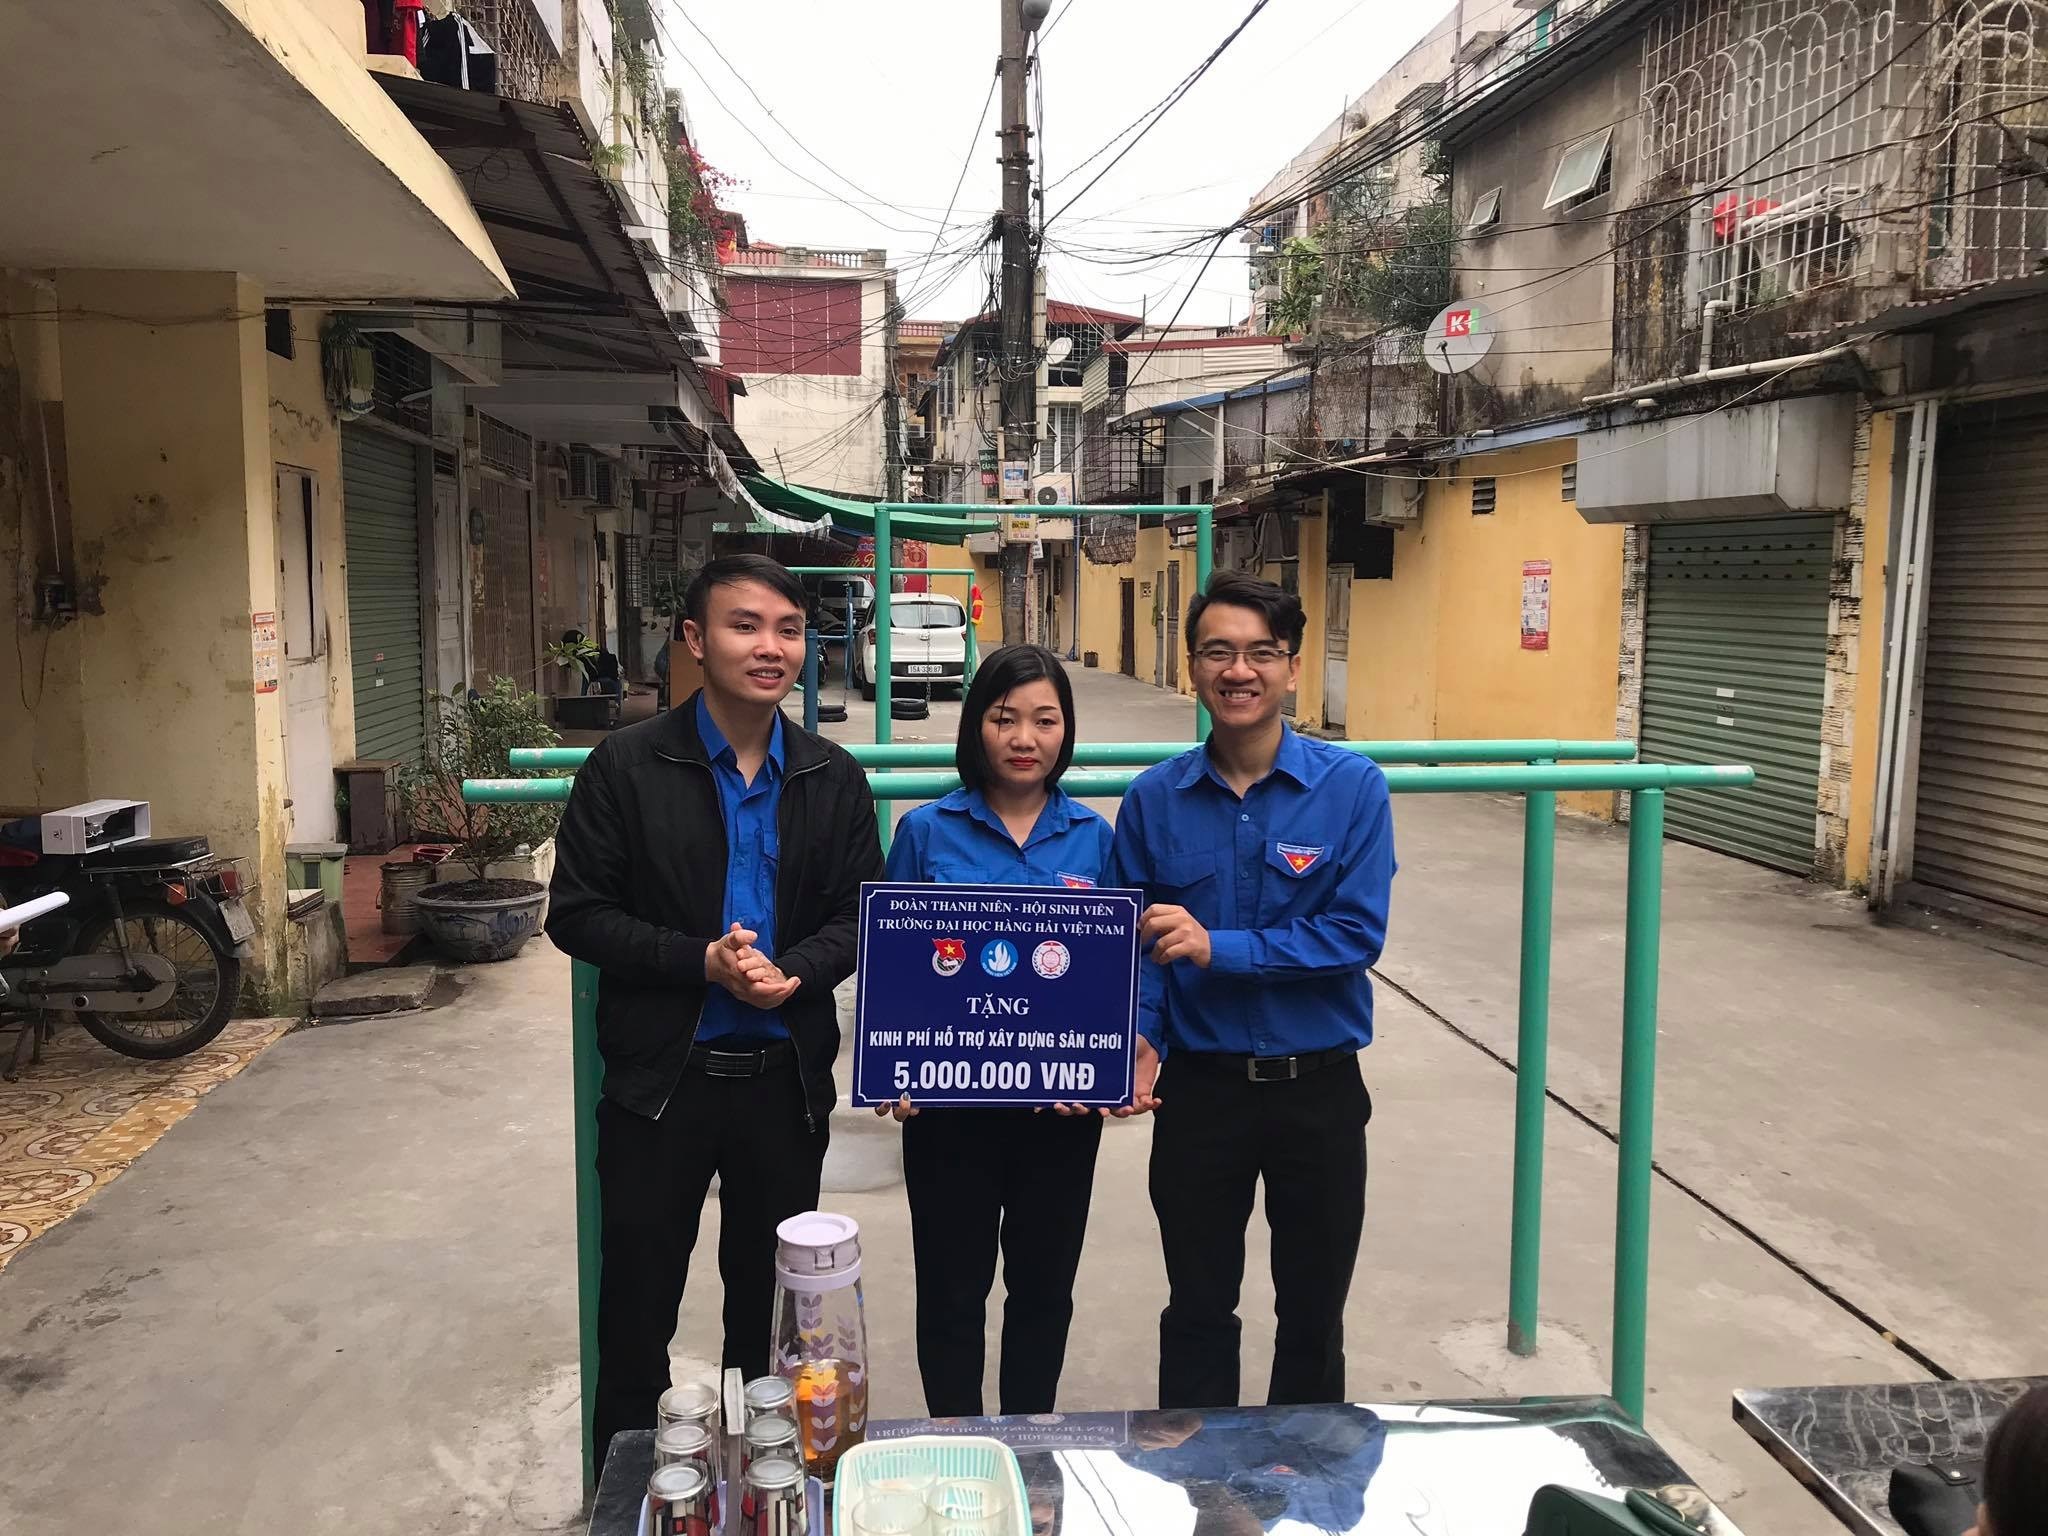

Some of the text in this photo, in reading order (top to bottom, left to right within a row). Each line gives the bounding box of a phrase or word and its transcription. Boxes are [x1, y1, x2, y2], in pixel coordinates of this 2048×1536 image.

[890, 897, 927, 911] ĐOÀN
[931, 901, 977, 912] THANH
[980, 900, 1011, 912] NIÊN
[1022, 901, 1046, 916] HỘI
[1049, 904, 1080, 915] SINH
[1083, 903, 1114, 916] VIÊN
[877, 917, 1125, 936] TRƯỜNG ĐẠI HỌC HÀNG HẢI VIỆT NAM
[967, 993, 1029, 1018] TẶNG
[870, 1025, 1121, 1050] KINH PHÍ HỖ TRỢ XÂY DỰNG SÂN CHƠI
[894, 1061, 1095, 1090] 5.000.000 VNĐ
